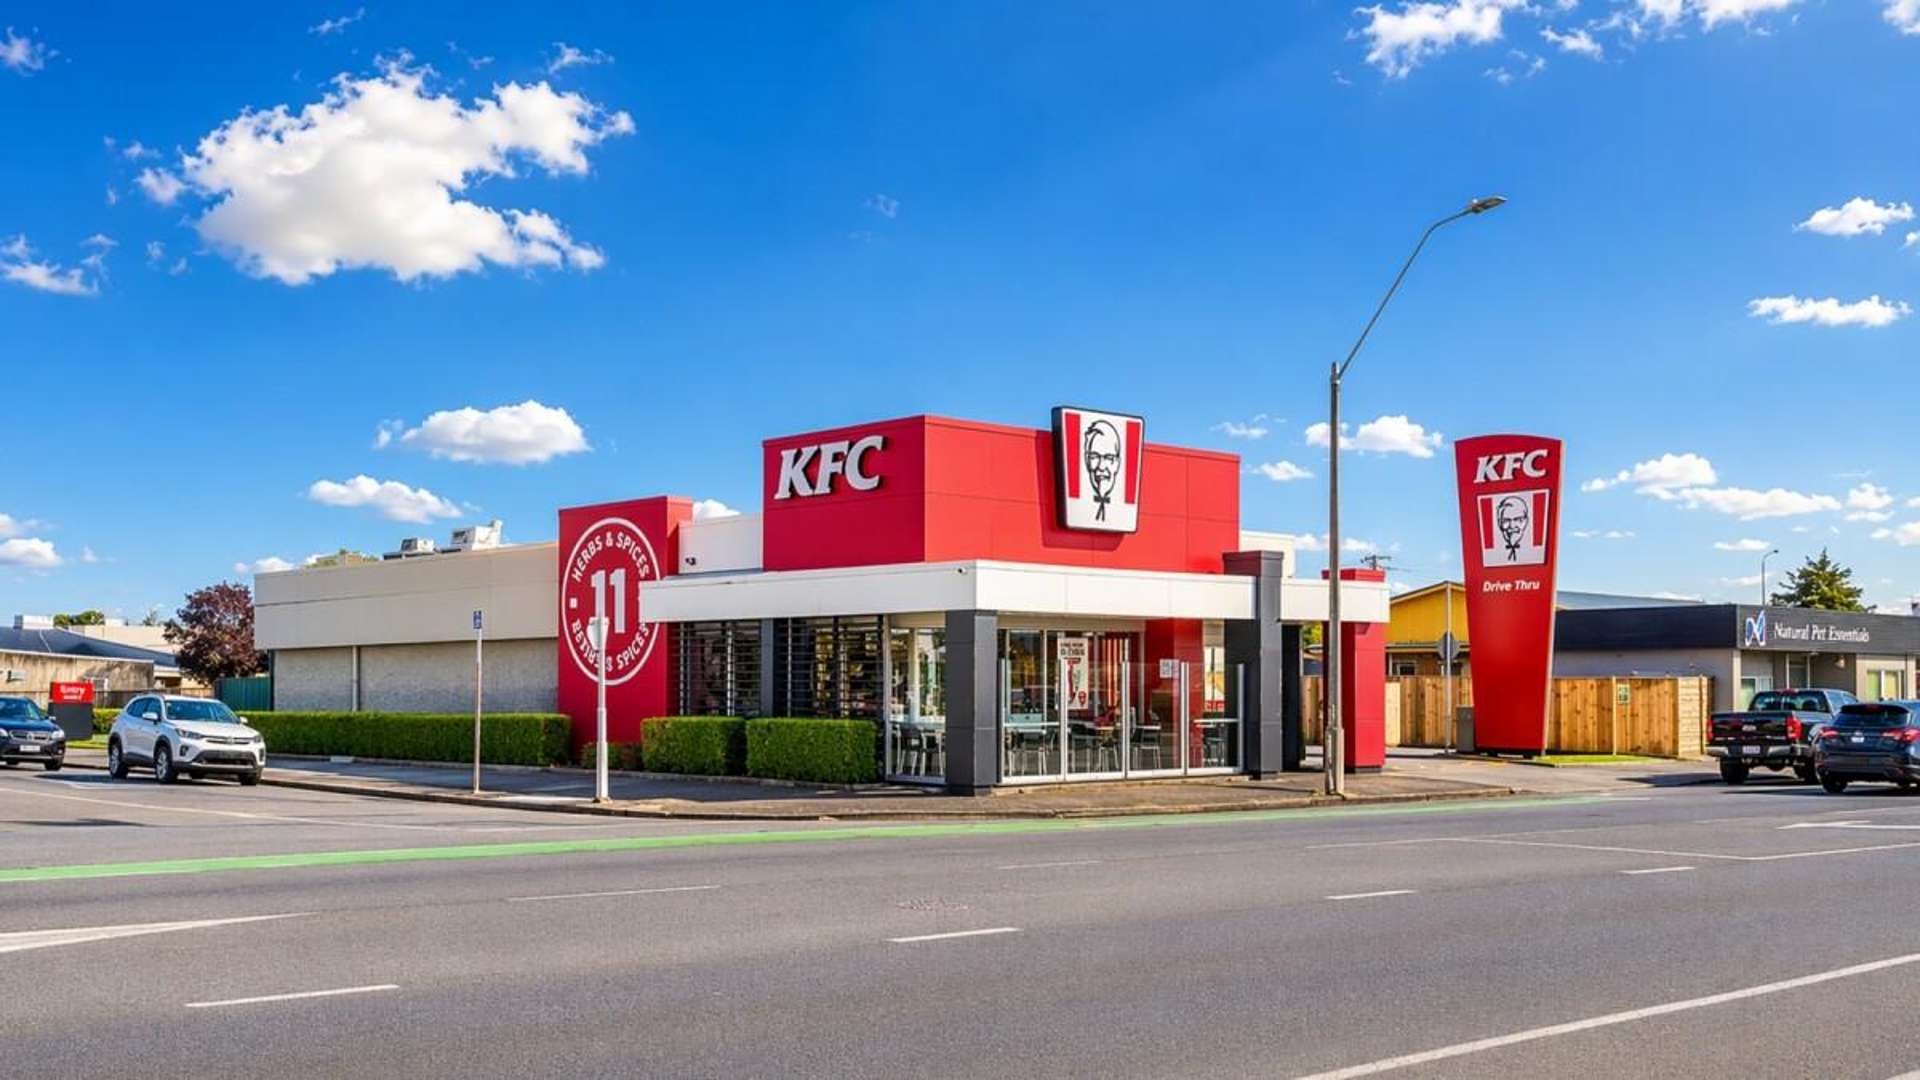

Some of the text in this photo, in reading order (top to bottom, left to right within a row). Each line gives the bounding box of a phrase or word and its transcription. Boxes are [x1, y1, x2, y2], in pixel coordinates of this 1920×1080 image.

[774, 435, 884, 499] KFC
[1473, 449, 1548, 483] KFC
[571, 531, 650, 582] HERBS & SPICES
[591, 568, 626, 634] 11
[1483, 579, 1540, 592] Drive Thru
[1774, 622, 1870, 642] Natural Pet Essentials
